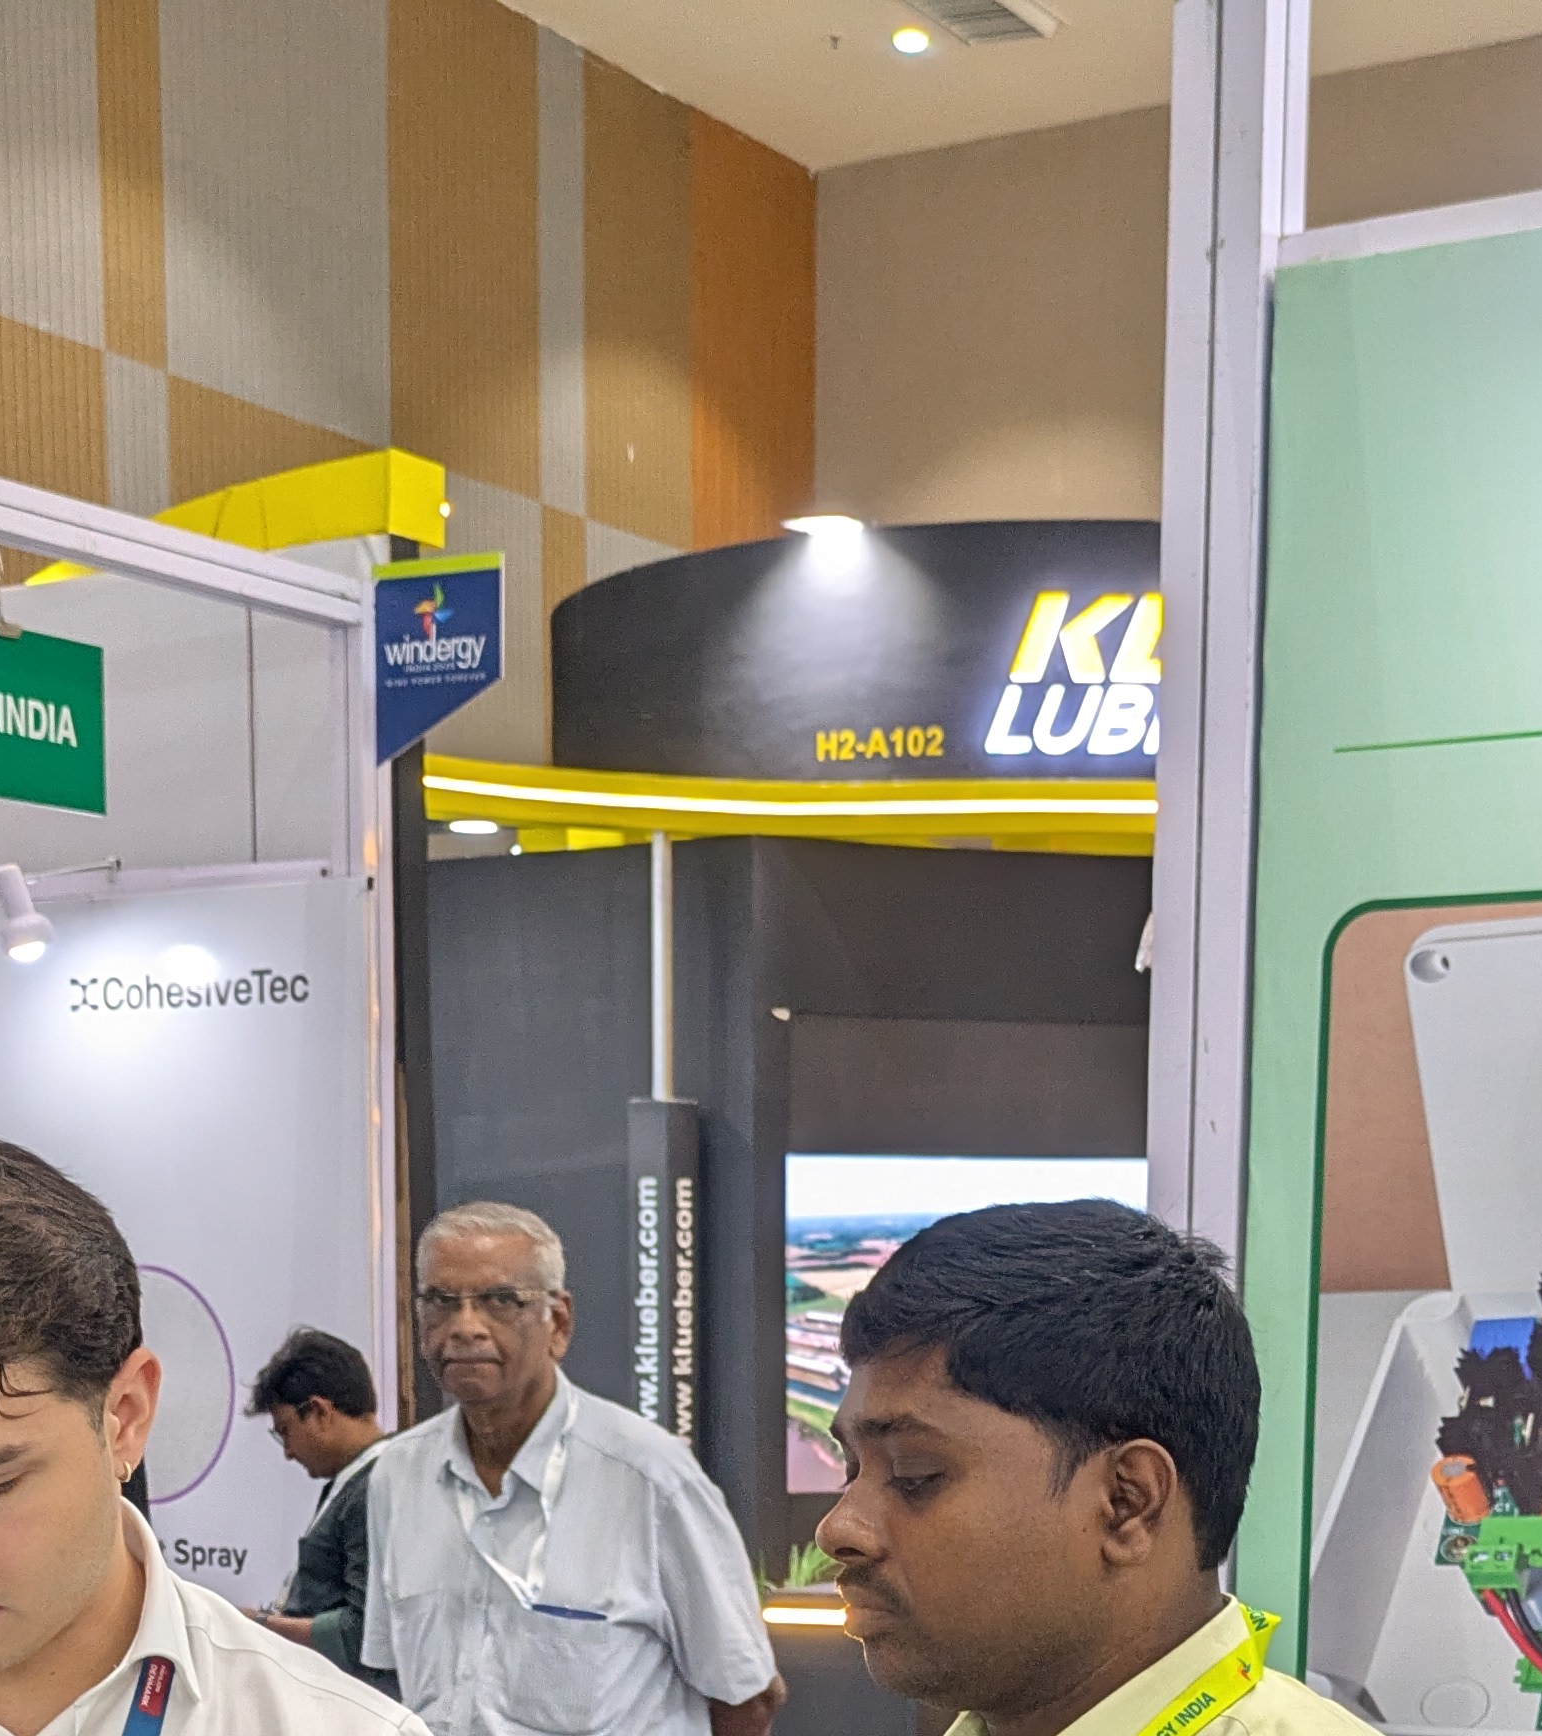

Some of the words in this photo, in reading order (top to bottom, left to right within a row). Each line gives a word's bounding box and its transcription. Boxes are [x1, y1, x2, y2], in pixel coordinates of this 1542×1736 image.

[384, 622, 487, 670] windergy
[816, 725, 944, 763] H2-A102
[102, 968, 310, 1011] CohesiveTec
[174, 1538, 249, 1577] Spray
[1174, 1690, 1217, 1733] INDIA
